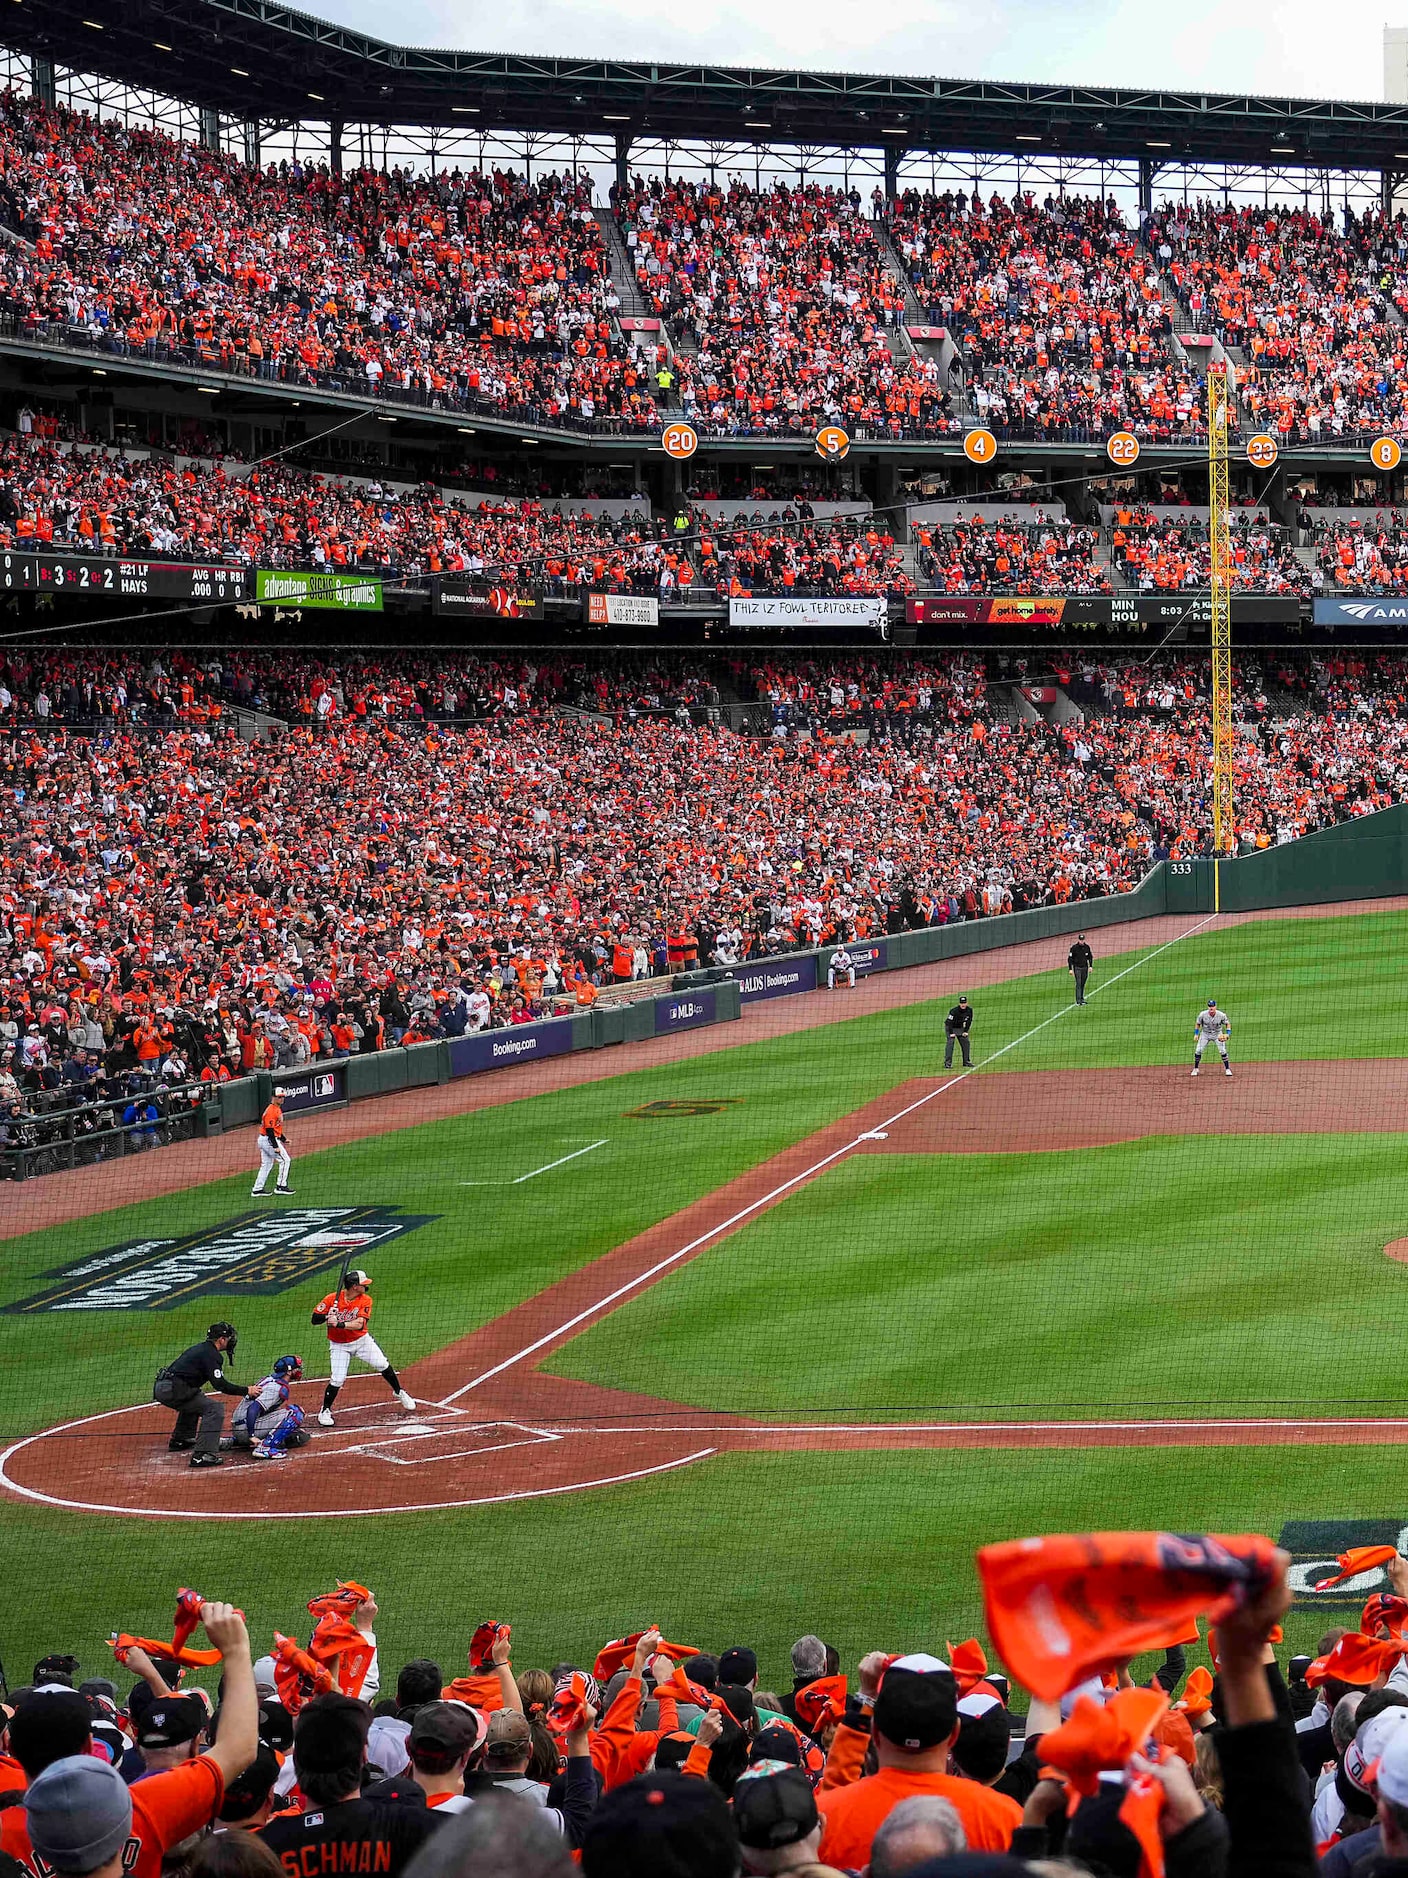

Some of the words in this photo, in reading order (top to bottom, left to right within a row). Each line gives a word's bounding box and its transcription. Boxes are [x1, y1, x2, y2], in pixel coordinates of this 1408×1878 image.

[668, 431, 693, 451] 20
[827, 433, 839, 452] 5
[972, 437, 986, 457] 4
[1112, 440, 1135, 459] 22
[1251, 441, 1277, 461] 33
[1379, 444, 1392, 463] 8
[54, 565, 65, 586] 3
[79, 566, 90, 588] 2
[103, 568, 114, 589] 2
[120, 563, 136, 576] #21
[139, 564, 149, 577] LF
[192, 568, 209, 582] AVG
[215, 569, 227, 582] HR
[230, 570, 245, 583] RBI
[121, 578, 148, 594] HAYS
[191, 583, 211, 598] .000
[218, 583, 226, 598] 0
[234, 584, 242, 599] 0
[264, 576, 307, 604] advantage
[309, 577, 334, 602] SIGNS
[446, 594, 465, 603] NATIONAL
[1111, 600, 1135, 610] MIN
[734, 602, 759, 613] THIZ
[763, 602, 775, 613] IZ
[780, 602, 808, 613] FOWL
[931, 610, 951, 619] don't
[952, 611, 969, 619] mix.
[1011, 607, 1034, 615] home
[1160, 606, 1183, 616] 8:03
[1111, 612, 1139, 622] HOU
[1171, 864, 1192, 875] 333
[744, 976, 765, 993] ALDS
[766, 972, 800, 988] Booking.com
[678, 1003, 694, 1019] MLB
[493, 1038, 537, 1056] Booking.com
[285, 1085, 308, 1098] king.com
[279, 1840, 392, 1878] SCHMAN
